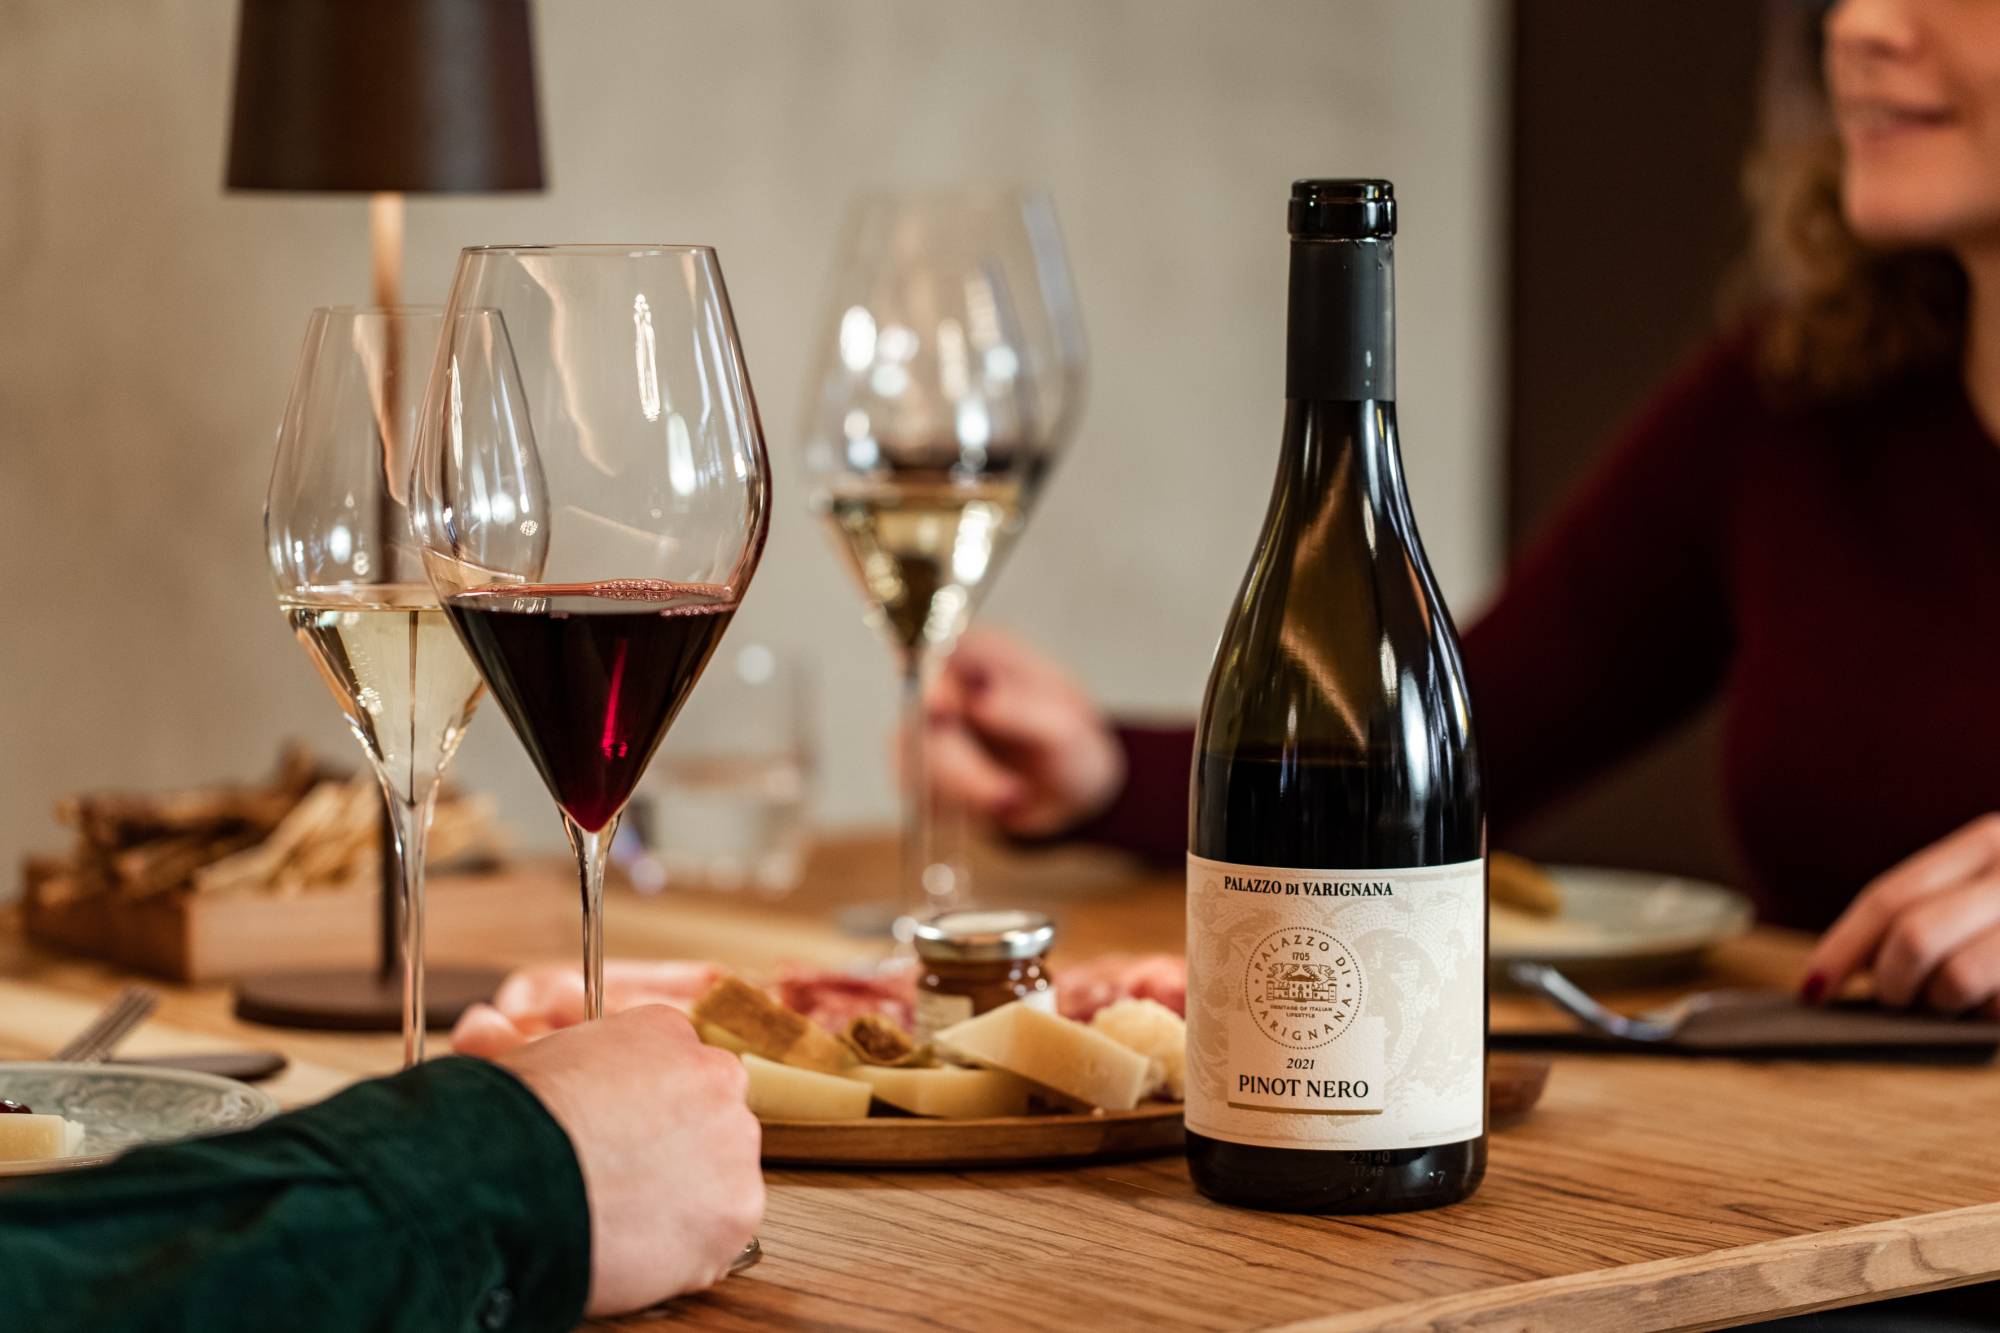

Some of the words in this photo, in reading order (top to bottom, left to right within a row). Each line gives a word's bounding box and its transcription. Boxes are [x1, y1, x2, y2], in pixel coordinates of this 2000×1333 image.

[1224, 876, 1282, 895] PALAZZO
[1285, 883, 1300, 896] DI
[1302, 881, 1394, 896] VARIGNANA
[1255, 934, 1330, 972] PALAZZO
[1335, 956, 1351, 975] DI
[1292, 952, 1310, 961] 1705
[1255, 995, 1352, 1041] VARIGNANA
[1286, 1057, 1315, 1071] 2021
[1239, 1074, 1301, 1097] PINOT
[1306, 1080, 1369, 1098] NERO
